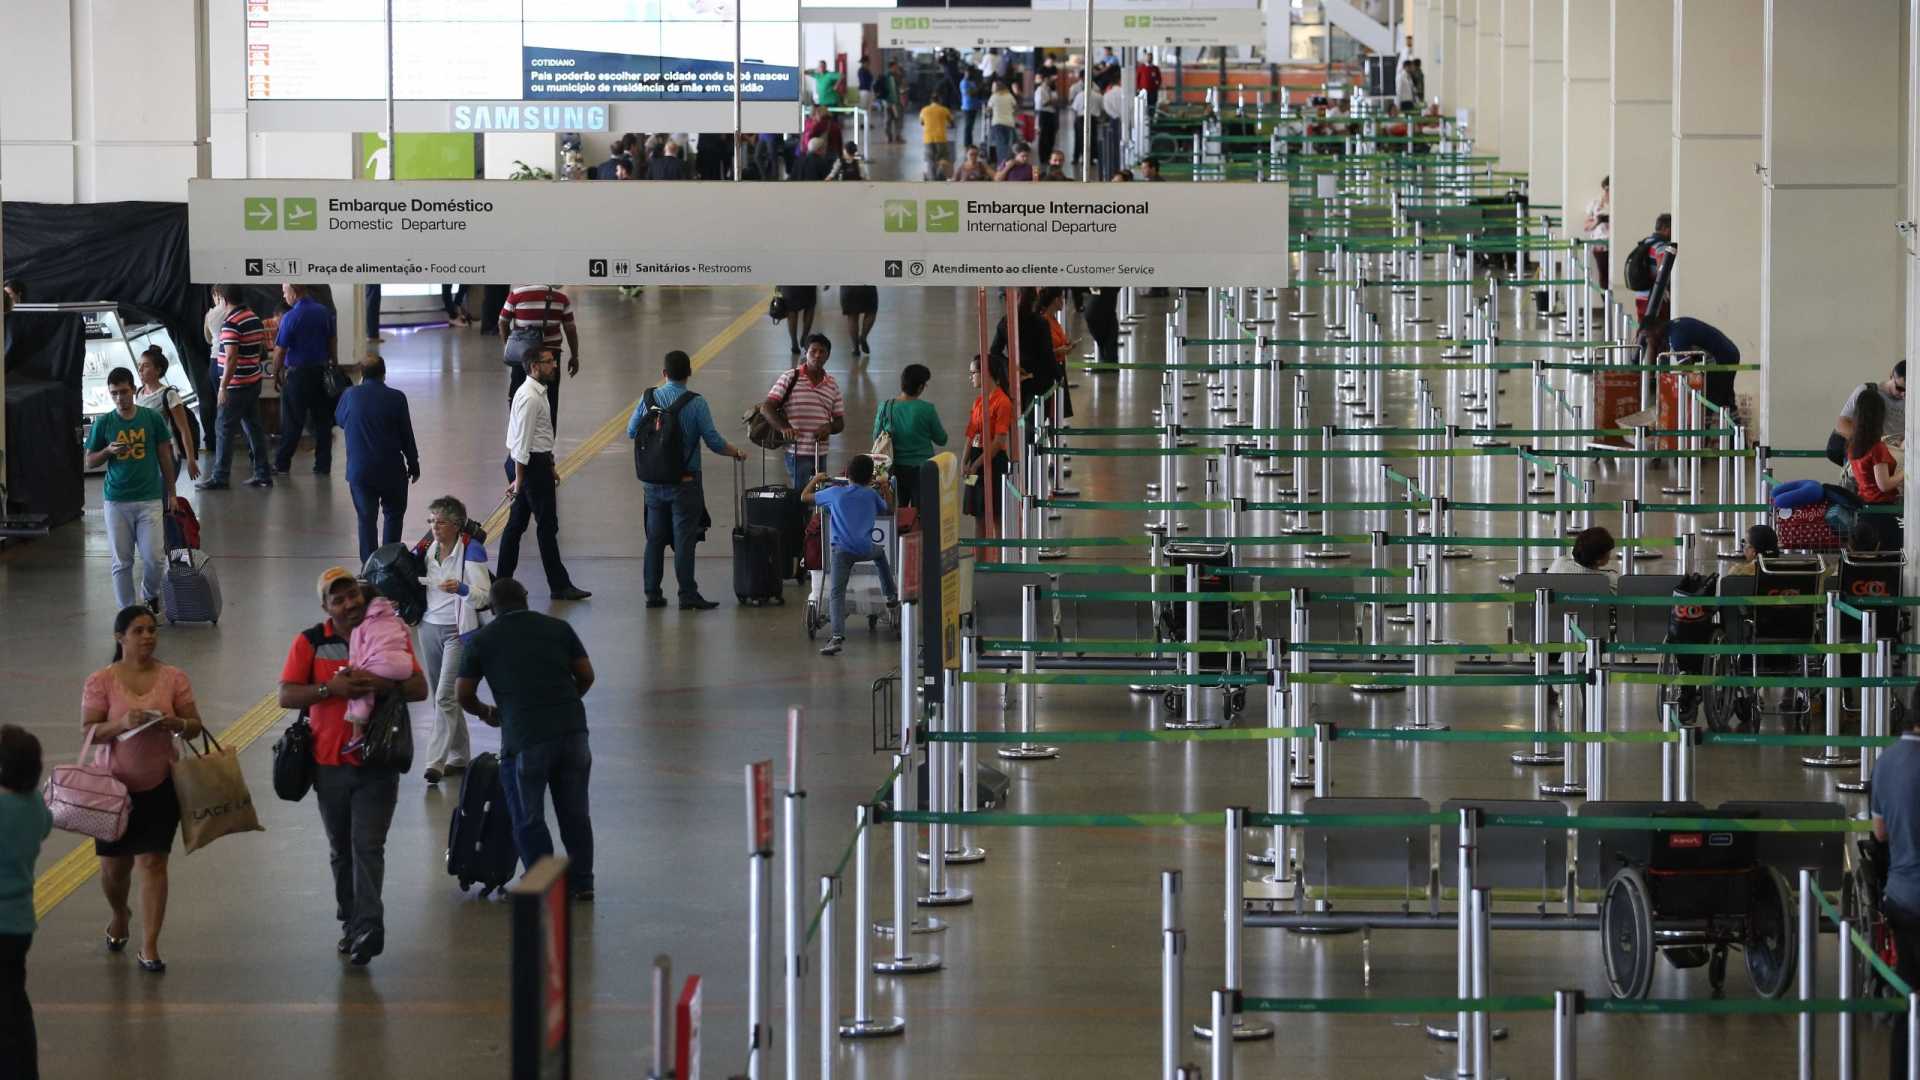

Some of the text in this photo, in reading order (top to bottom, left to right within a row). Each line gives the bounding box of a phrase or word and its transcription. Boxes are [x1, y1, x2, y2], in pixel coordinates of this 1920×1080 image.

[531, 59, 576, 67] COTIDIANO
[531, 71, 553, 81] Pais
[555, 71, 596, 83] poderão
[598, 71, 641, 81] escolher
[643, 73, 661, 83] por
[664, 71, 697, 81] cidade
[699, 71, 725, 81] onde
[753, 72, 790, 81] nasceu
[531, 84, 545, 93] ou
[598, 82, 611, 93] de
[666, 83, 680, 92] da
[682, 83, 703, 92] mãe
[705, 84, 721, 92] em
[455, 105, 604, 130] SAMSUNG
[329, 197, 494, 214] Embarque Doméstico
[967, 200, 1149, 216] Embarque Internacional
[329, 217, 467, 232] Domestic Departure
[967, 219, 1117, 235] International Departure
[308, 261, 486, 276] Praça de alimentação Food court
[636, 262, 752, 273] Sanitários Restrooms
[932, 263, 1155, 276] Atendimento ao cliente Customer Service
